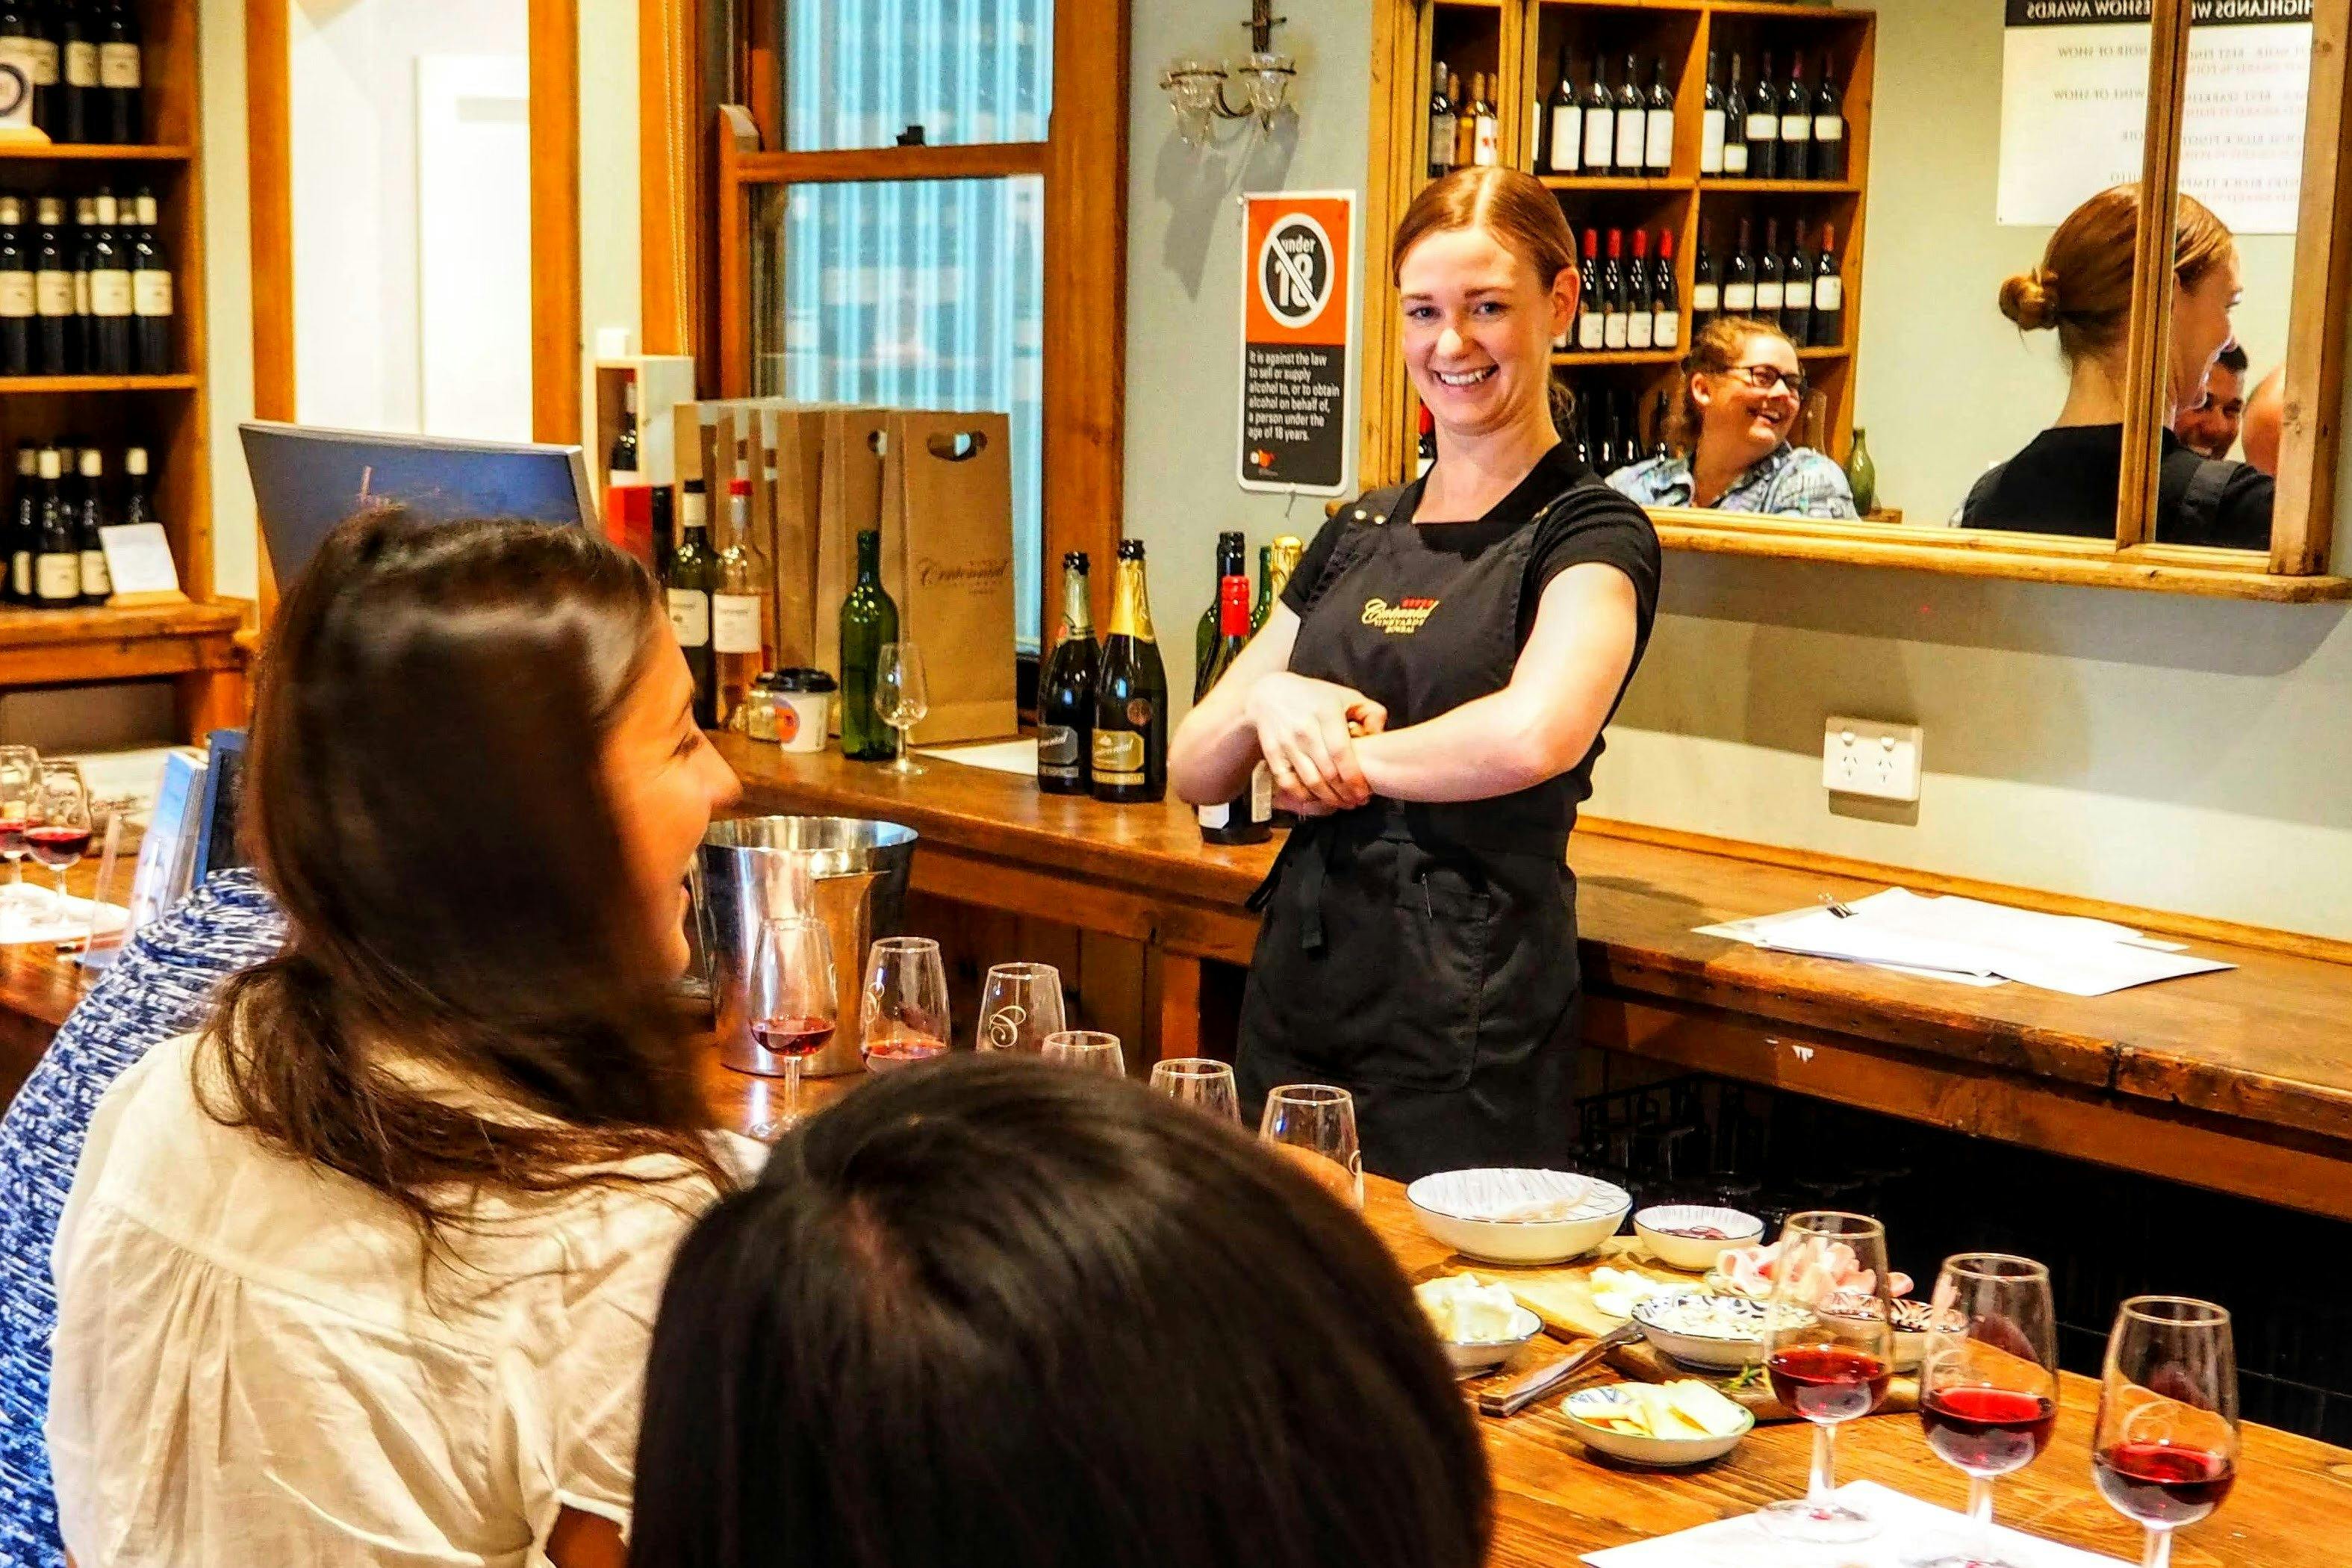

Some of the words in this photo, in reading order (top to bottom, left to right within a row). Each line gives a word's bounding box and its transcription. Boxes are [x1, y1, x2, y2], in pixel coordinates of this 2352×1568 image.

[1280, 234, 1316, 254] under
[1275, 253, 1314, 308] 18
[1257, 351, 1264, 365] is
[1265, 352, 1295, 367] against
[1295, 352, 1310, 366] the
[1310, 352, 1328, 367] law
[1249, 367, 1258, 379] to
[1259, 366, 1273, 379] sell
[1273, 369, 1283, 379] or
[1284, 367, 1312, 383] supply
[1249, 381, 1278, 394] alcohol
[1291, 383, 1301, 396] or
[1301, 384, 1312, 396] to
[1312, 382, 1340, 397] obtain
[1249, 396, 1278, 409] alcohol
[1279, 399, 1290, 411] on
[1290, 396, 1318, 411] behalf
[1248, 412, 1254, 423] a
[1255, 412, 1284, 426] person
[1284, 412, 1309, 426] under
[1310, 413, 1325, 427] the
[1248, 426, 1263, 441] age
[1263, 426, 1273, 438] of
[1274, 426, 1284, 439] 18
